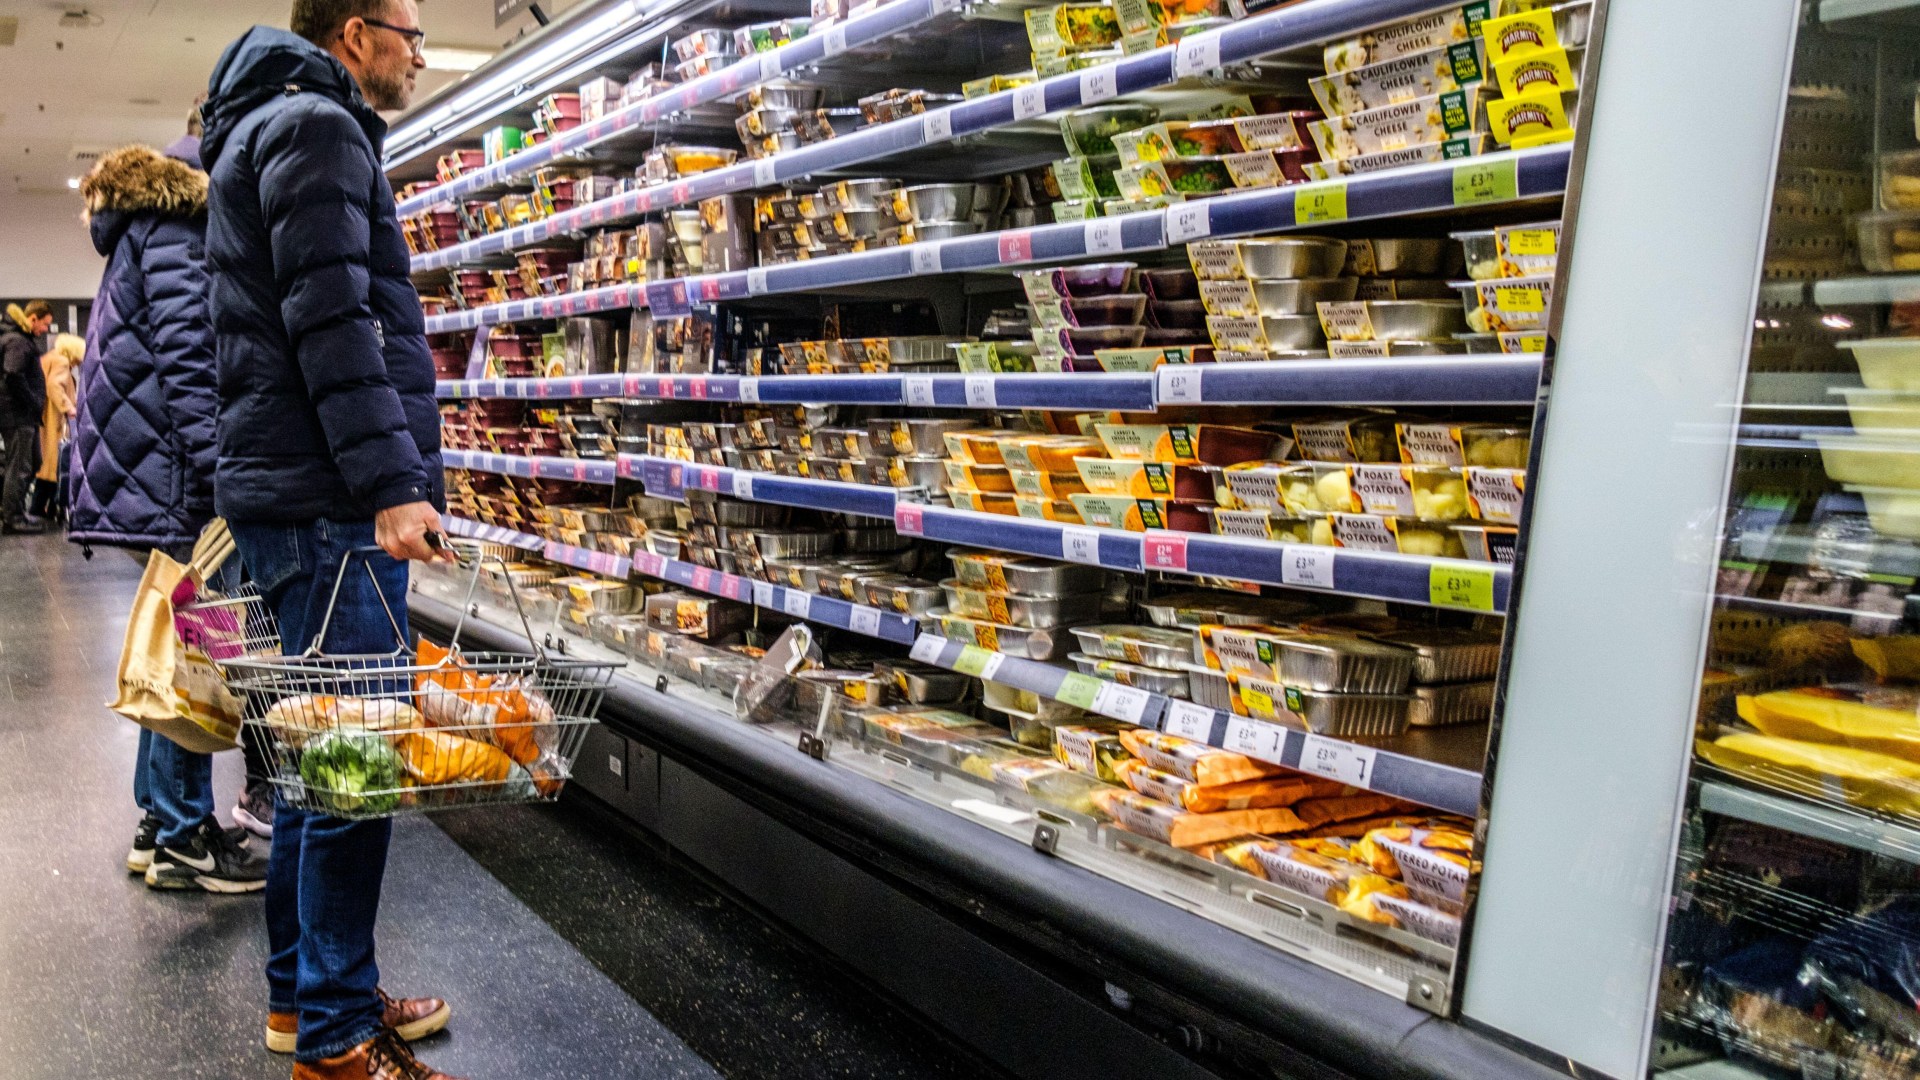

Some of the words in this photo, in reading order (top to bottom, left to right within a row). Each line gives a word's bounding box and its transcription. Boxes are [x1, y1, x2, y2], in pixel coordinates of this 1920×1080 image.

[1377, 16, 1445, 41] CAULIFLOWER
[1396, 36, 1431, 52] CHEESE
[1504, 29, 1538, 48] MARMITE
[1360, 54, 1429, 82] CAULIFLOWER
[1380, 75, 1415, 91] CHEESE
[1517, 69, 1552, 87] MARMITE
[1356, 103, 1421, 125] CAULIFLOWER
[1510, 110, 1545, 128] MARMITE
[1240, 117, 1287, 128] CAULIFLOWER
[1374, 121, 1407, 137] CHEESE
[1229, 155, 1269, 165] CAULIFLOWER
[1354, 149, 1422, 169] CAULIFLOWER
[1243, 165, 1264, 173] CHEESE
[1314, 195, 1324, 207] £7
[1322, 308, 1363, 316] CAULIFLOWER
[1334, 348, 1383, 356] CAULIFLOWER
[1297, 428, 1346, 437] PARMENTIER
[1413, 431, 1443, 440] ROAST
[1305, 440, 1346, 449] POTATOES
[1407, 442, 1454, 453] POTATOES
[1228, 475, 1276, 485] PARMENTIER
[1363, 471, 1393, 480] ROAST
[1479, 476, 1505, 485] ROAST
[1235, 487, 1276, 498] POTATOES
[1357, 484, 1404, 495] POTATOES
[1474, 489, 1517, 502] POTATOES
[1220, 515, 1265, 525] PARMENTIER
[1345, 520, 1376, 529] ROAST
[1227, 527, 1265, 537] POTATOES
[1340, 532, 1389, 544] POTATOES
[1223, 635, 1246, 646] ROAST
[1219, 647, 1255, 660] POTATOES
[1250, 683, 1274, 695] ROAST
[1062, 734, 1089, 748] ROASTING
[1065, 747, 1089, 759] PARSNIPS
[1296, 868, 1337, 887] POTATO
[1411, 871, 1445, 893] SLICES
